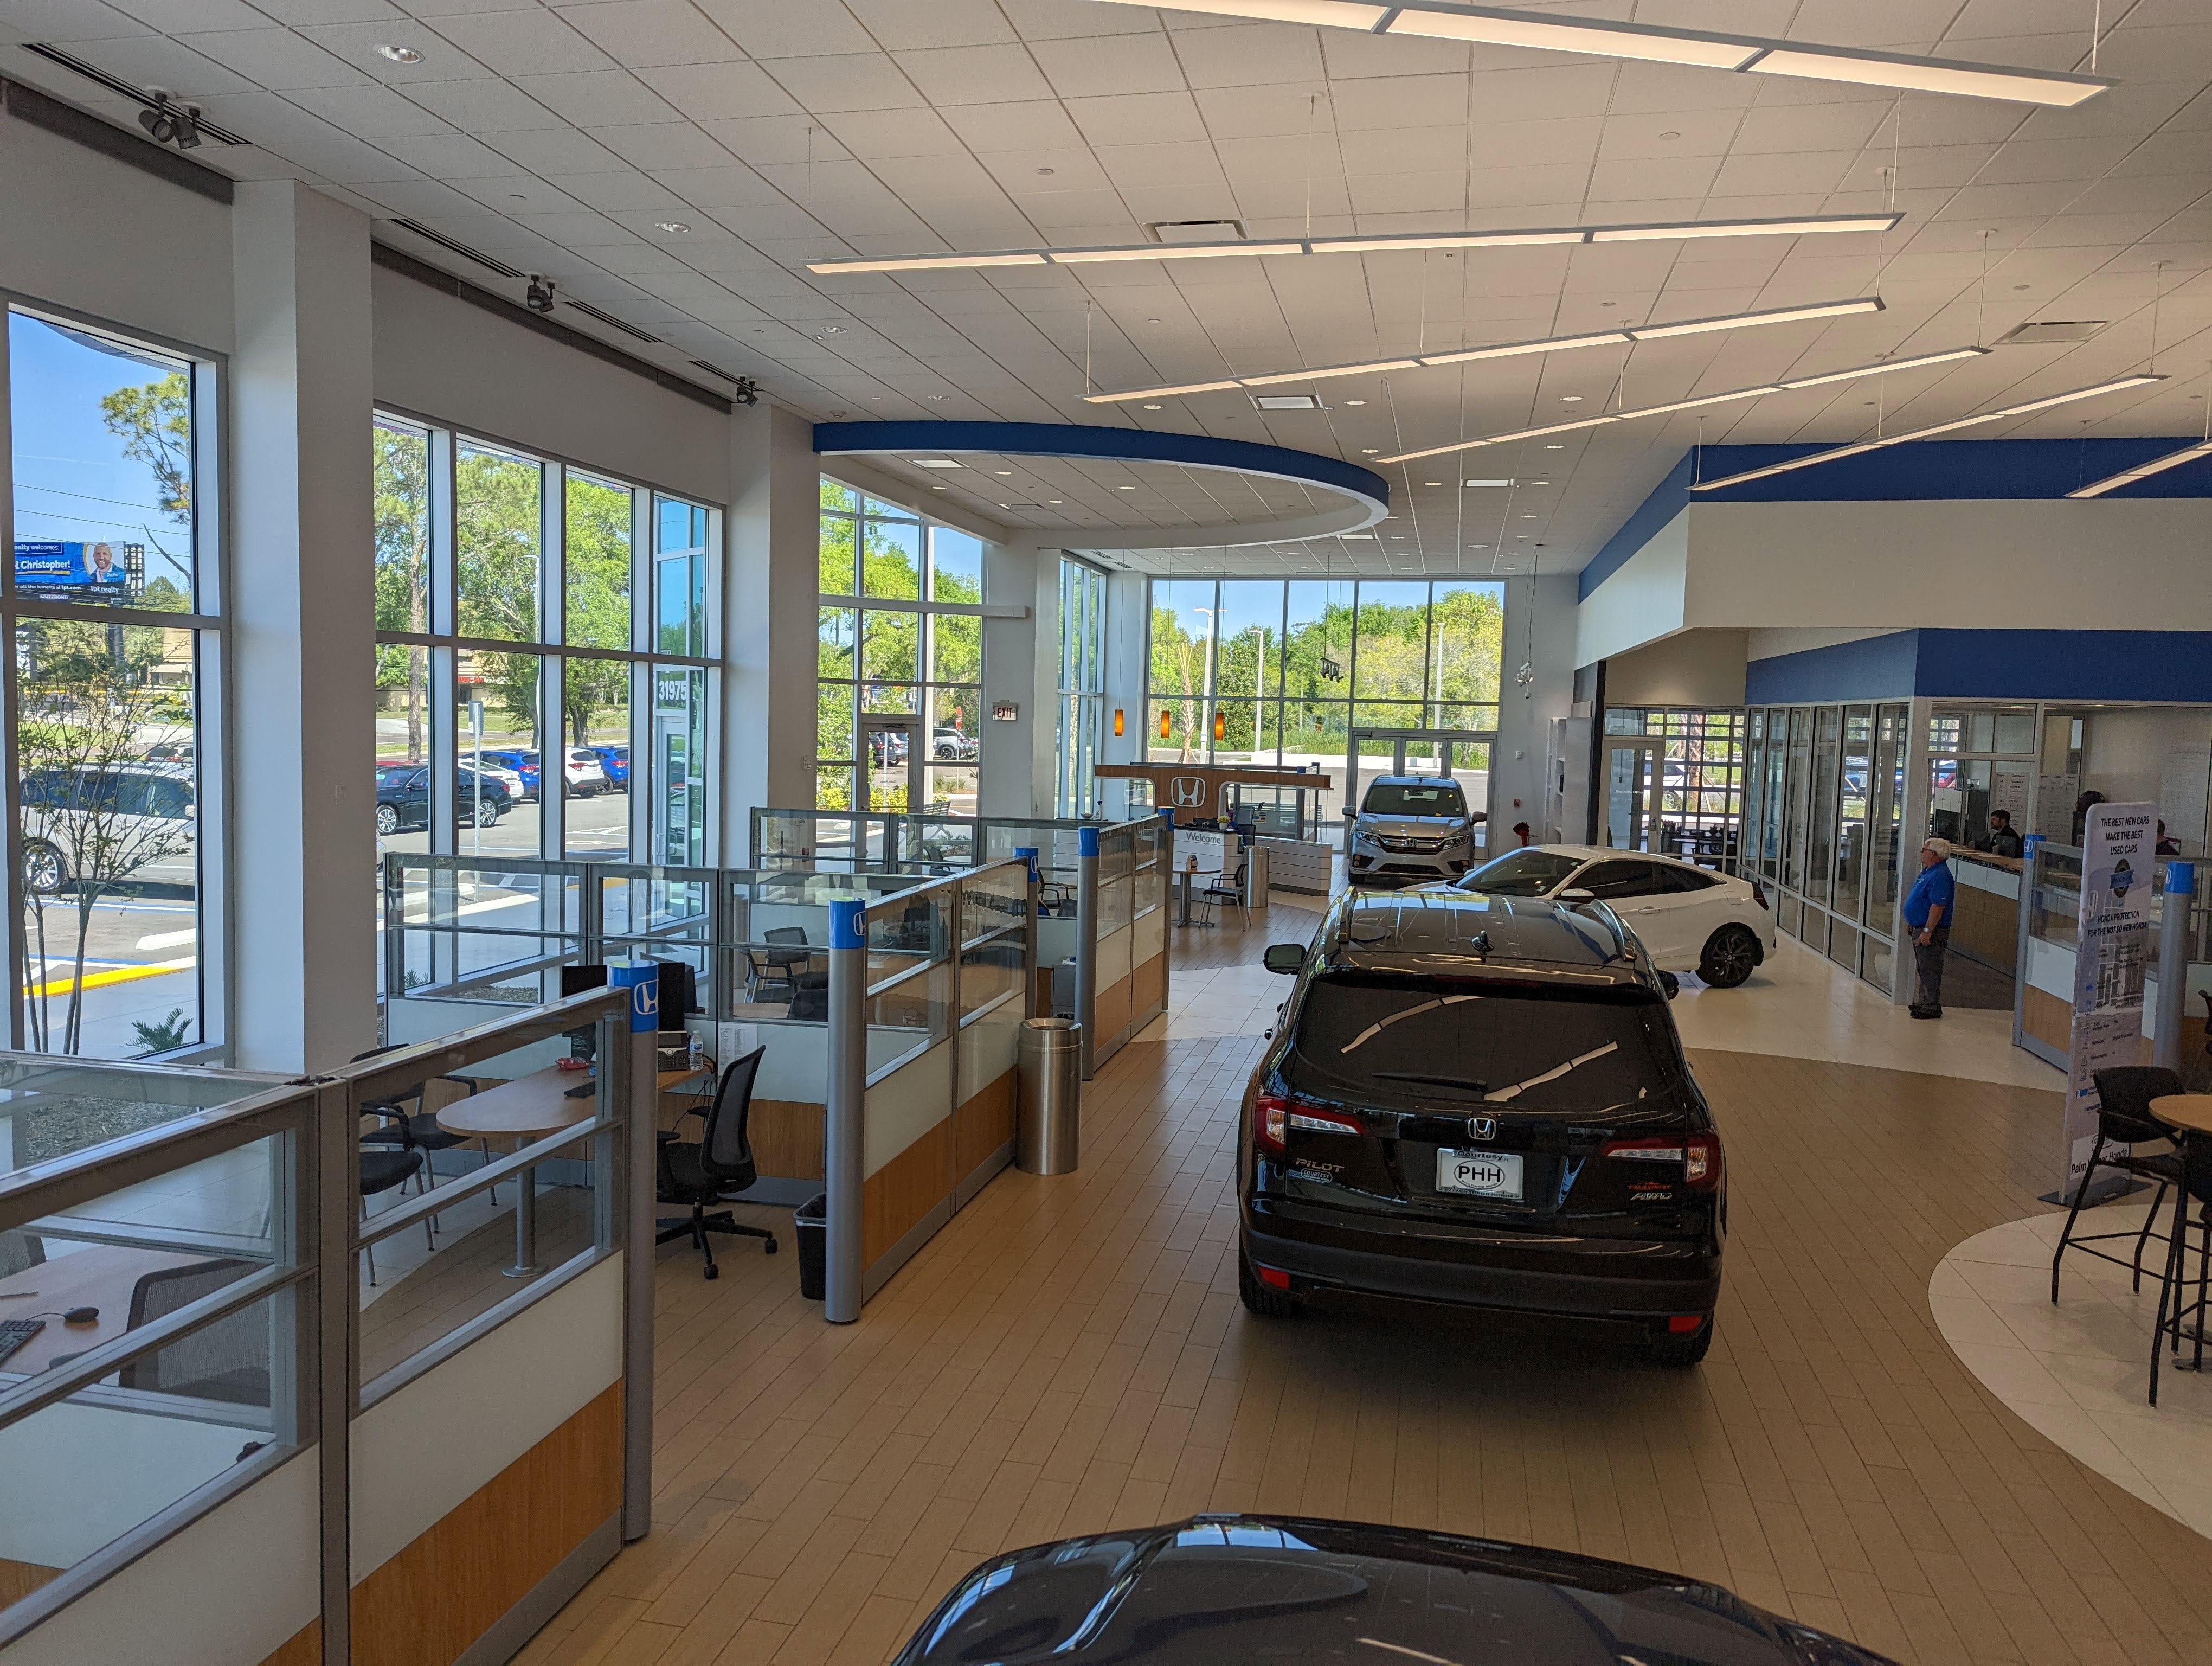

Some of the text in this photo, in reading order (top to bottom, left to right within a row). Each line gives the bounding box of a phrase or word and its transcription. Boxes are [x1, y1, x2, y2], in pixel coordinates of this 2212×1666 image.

[21, 560, 70, 571] Christopher!
[659, 680, 687, 700] 31975
[997, 707, 1013, 719] EXIT
[2101, 816, 2149, 827] THE BEST NEW CARS
[1186, 831, 1221, 844] Welcome
[2106, 830, 2143, 841] MAKE THE BEST
[2110, 844, 2137, 855] USED CARS
[2098, 910, 2140, 922] HONDA PROTECTION
[2087, 929, 2097, 937] FOR
[2123, 924, 2132, 932] NEW
[2133, 921, 2147, 930] HONDA
[1458, 1151, 1503, 1161] Courtesy
[2071, 1162, 2086, 1175] Palm
[2109, 1148, 2127, 1161] Honda
[1295, 1158, 1345, 1172] PILOT
[1303, 1170, 1329, 1178] COURTESY
[1458, 1166, 1501, 1183] PHH
